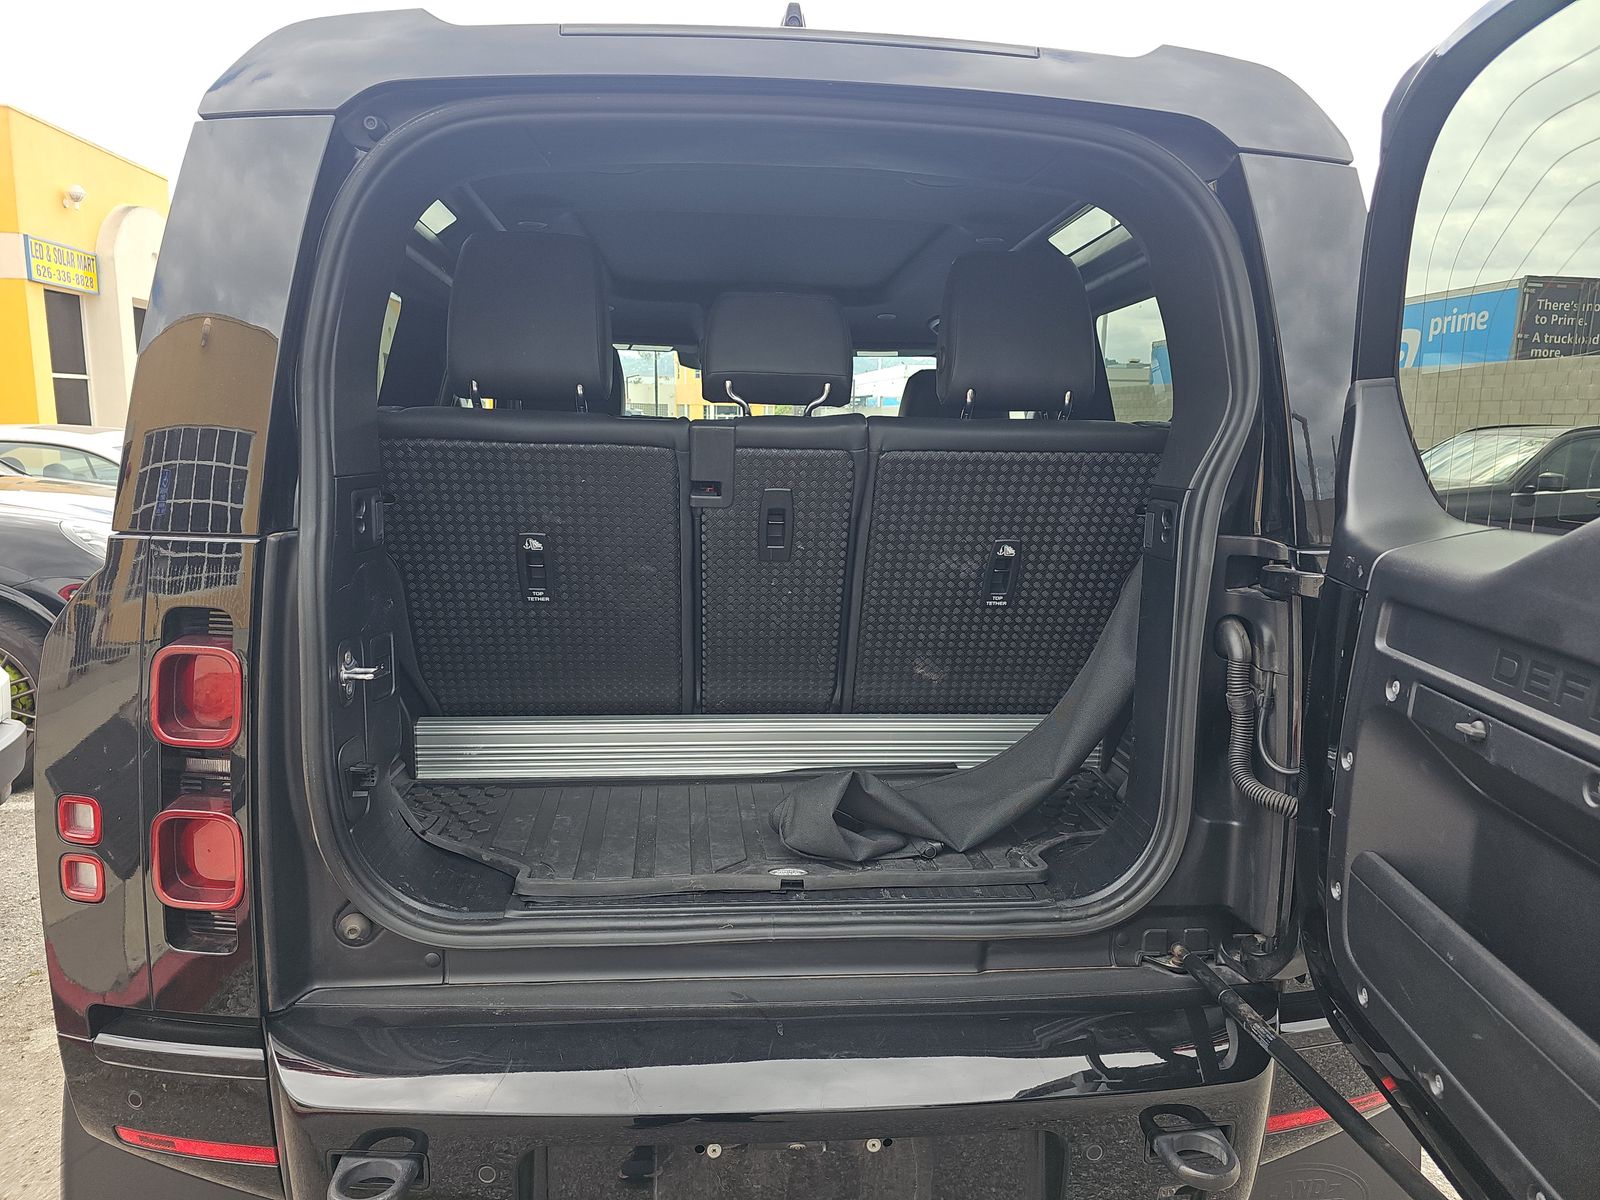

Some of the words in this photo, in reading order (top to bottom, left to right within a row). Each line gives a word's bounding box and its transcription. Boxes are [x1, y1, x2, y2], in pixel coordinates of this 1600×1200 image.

[30, 240, 43, 260] LED
[46, 245, 52, 262] &
[53, 247, 76, 269] SOLAR
[77, 253, 95, 273] MART
[1537, 299, 1578, 311] There's
[1428, 307, 1489, 342] prime
[1535, 314, 1547, 325] to
[1532, 332, 1540, 343] A
